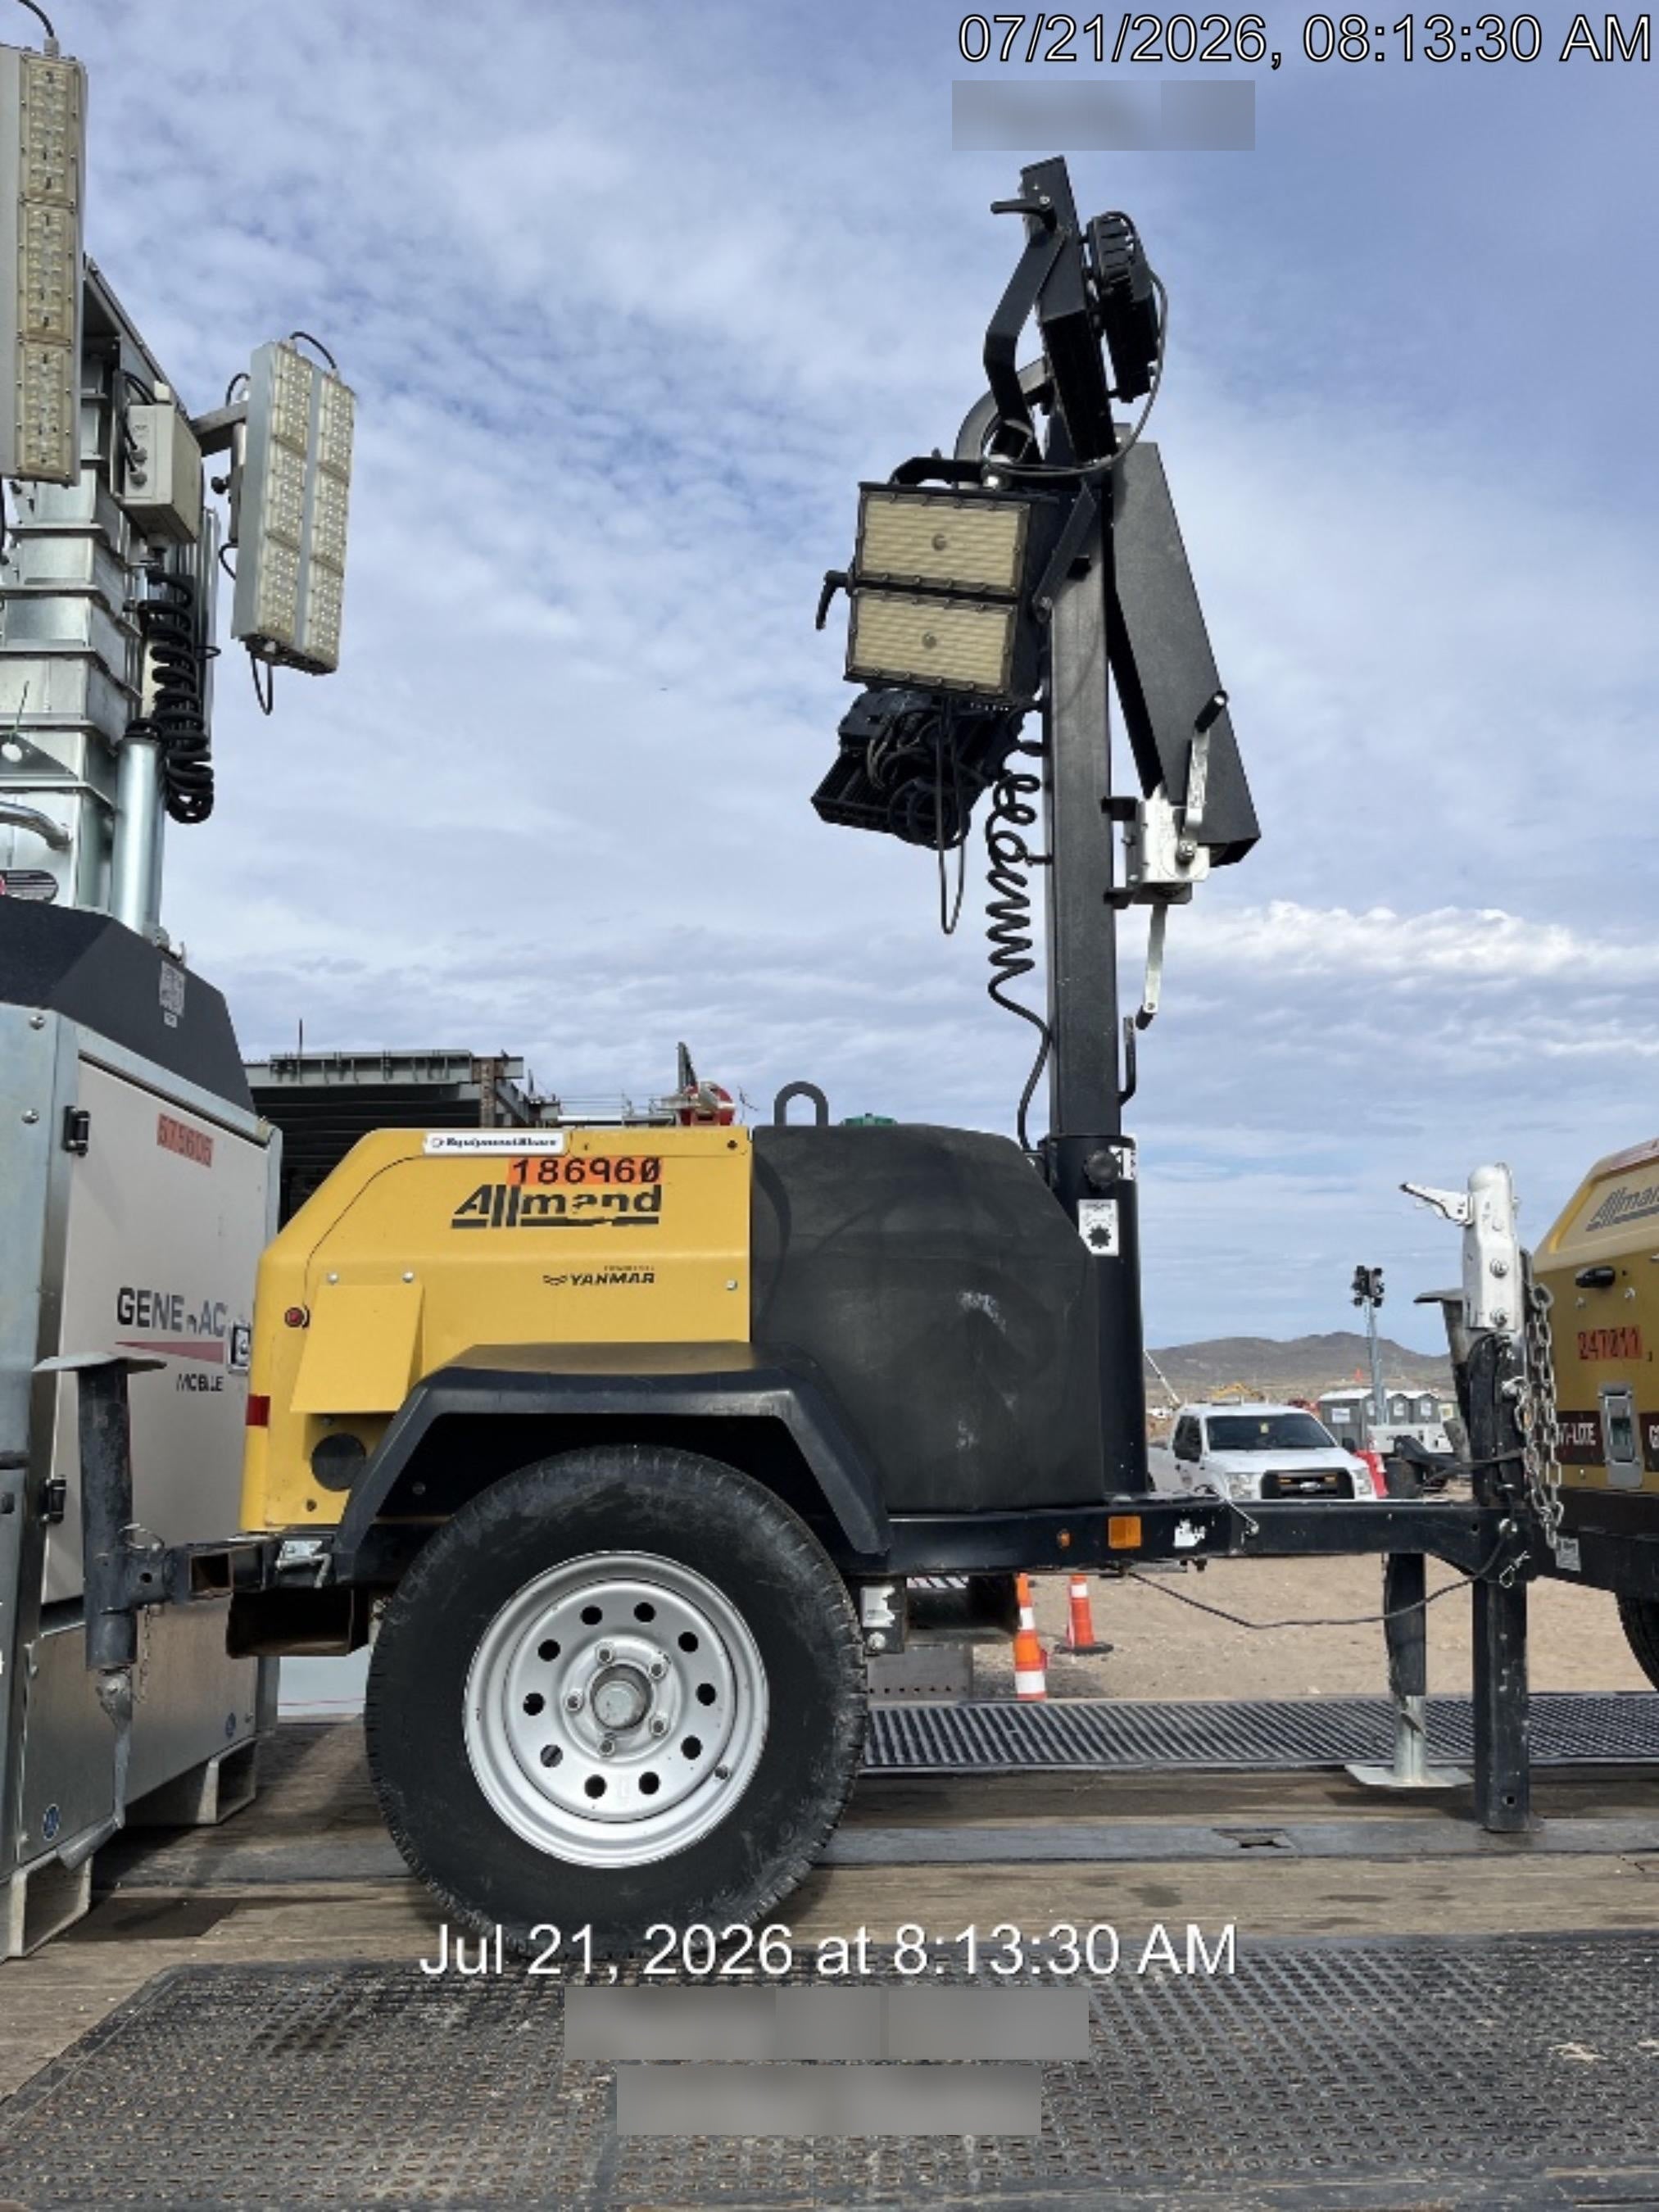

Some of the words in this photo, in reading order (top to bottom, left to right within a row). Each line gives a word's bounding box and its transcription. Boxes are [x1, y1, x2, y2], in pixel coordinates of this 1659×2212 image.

[513, 1158, 660, 1185] 186960
[452, 1185, 662, 1228] Allmand
[571, 1272, 655, 1285] YANMAR
